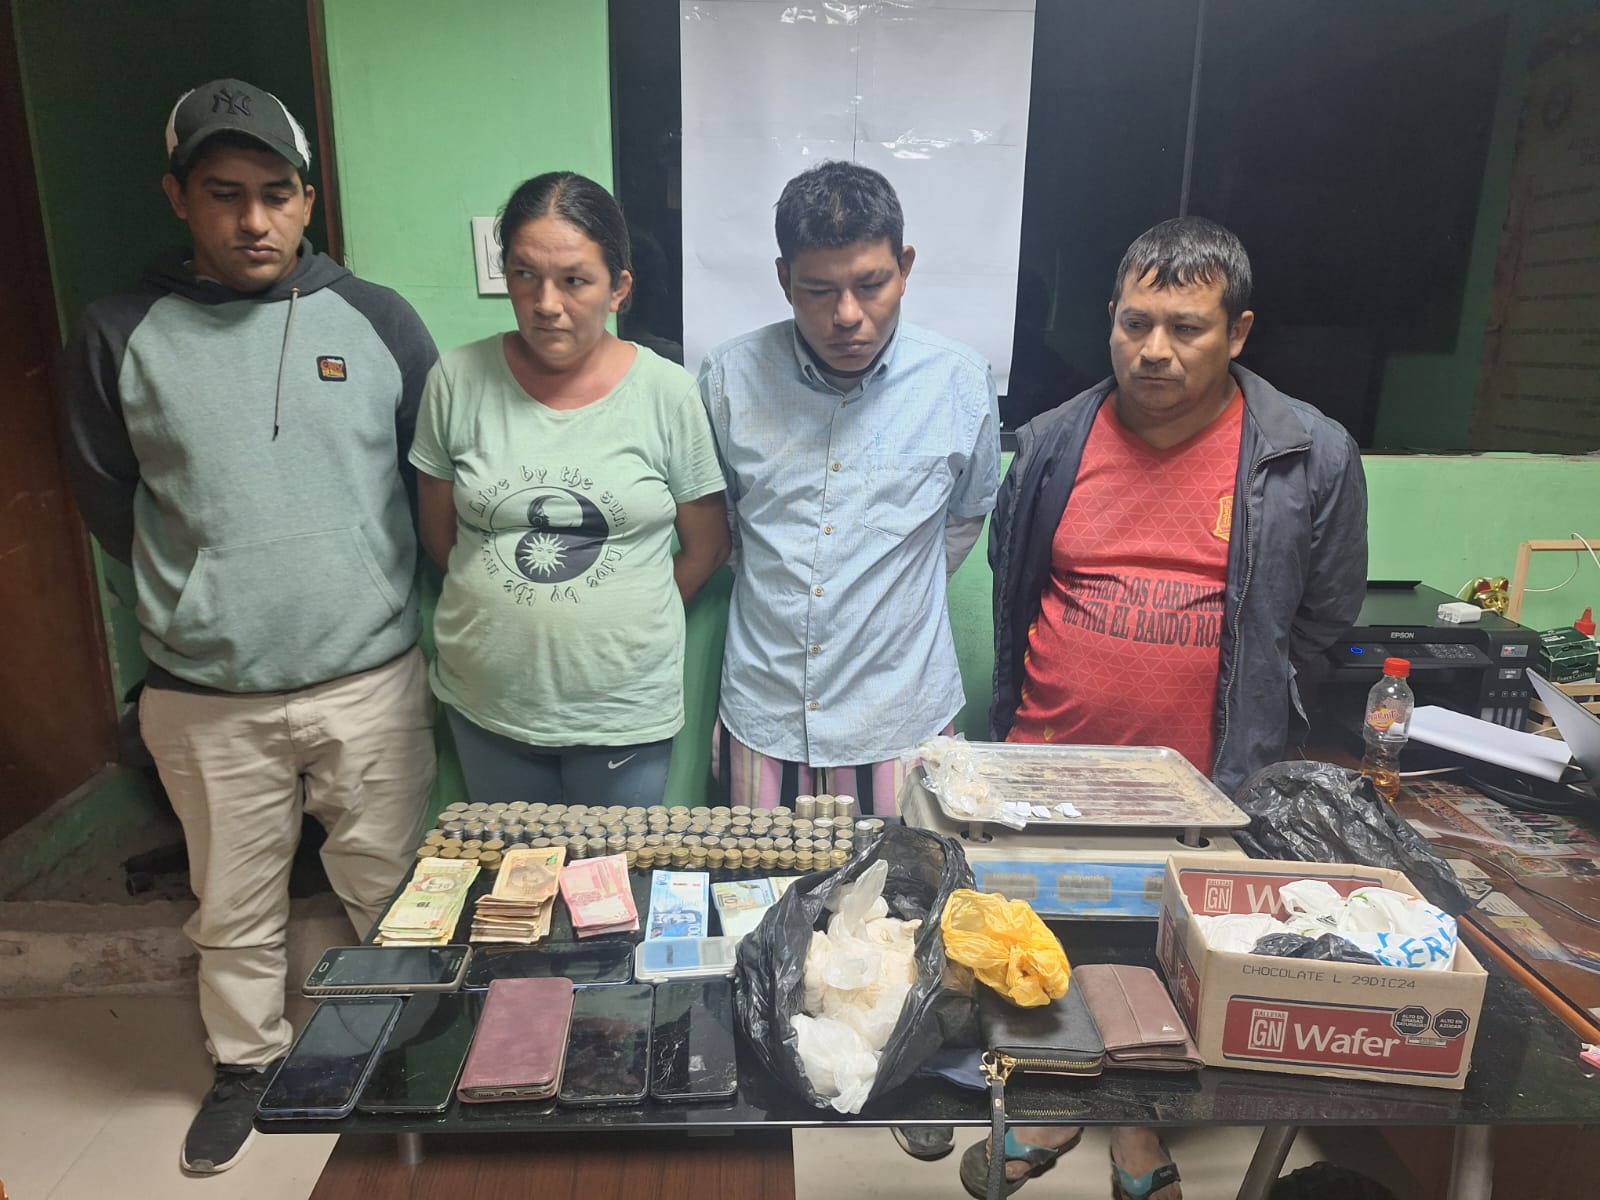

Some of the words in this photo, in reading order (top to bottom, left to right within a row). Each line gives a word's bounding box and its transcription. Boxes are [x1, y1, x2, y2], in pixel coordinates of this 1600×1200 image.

[212, 88, 251, 116] NY
[469, 479, 510, 518] Live
[520, 465, 547, 484] by
[560, 466, 593, 490] the
[600, 491, 627, 527] sun
[587, 545, 623, 588] Live
[503, 579, 536, 606] the
[551, 585, 580, 604] by
[1119, 576, 1150, 608] LOS
[1108, 606, 1130, 639] EL
[1133, 609, 1190, 646] BANDO
[1390, 631, 1415, 639] EPSON
[1207, 887, 1230, 910] GN
[1242, 964, 1325, 982] CHOCOLATE
[1333, 974, 1342, 983] L
[1351, 975, 1416, 990] 29DIC24
[1252, 1018, 1283, 1048] GN
[1294, 1023, 1400, 1057] Wafer
